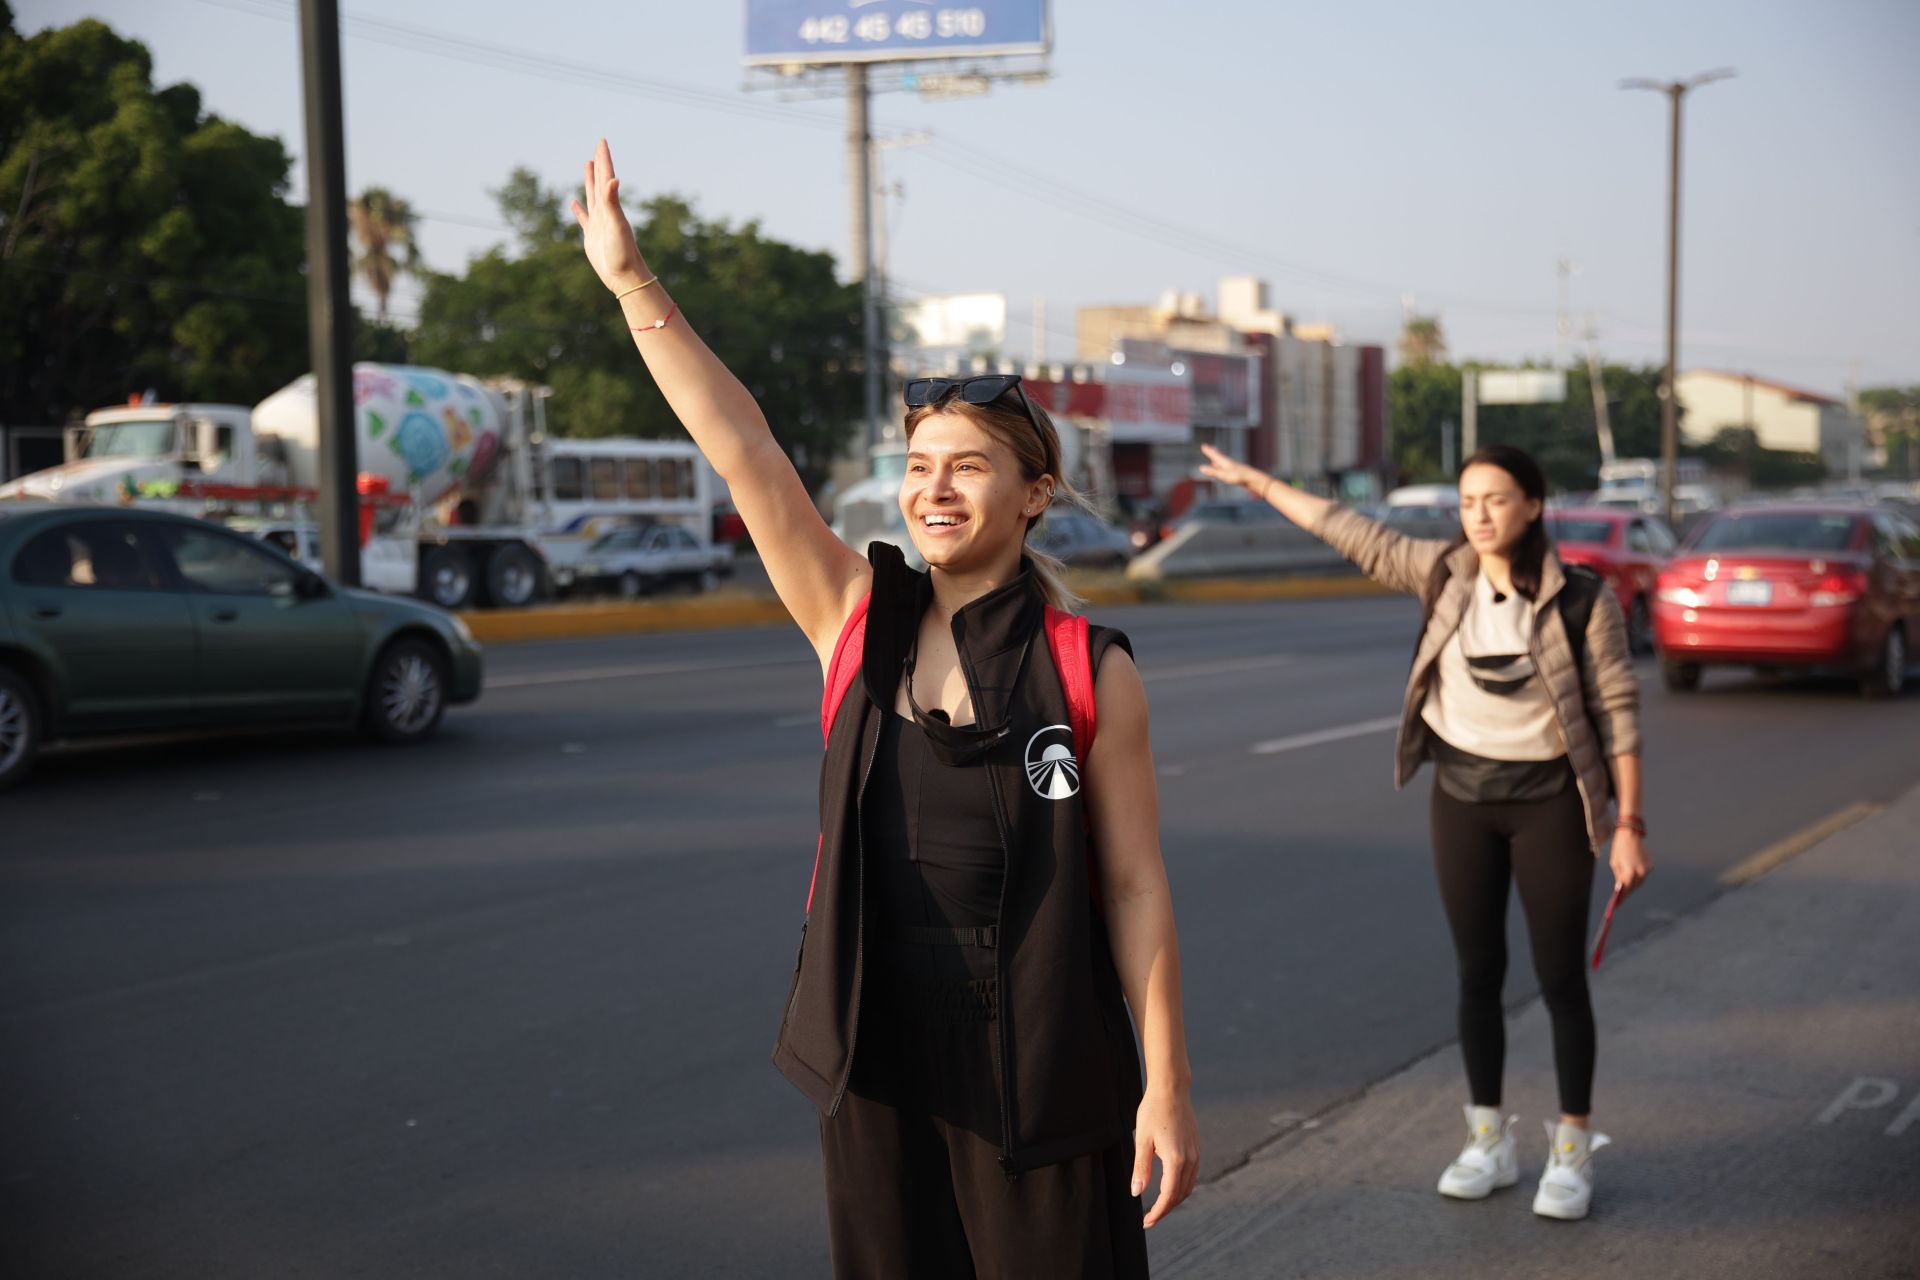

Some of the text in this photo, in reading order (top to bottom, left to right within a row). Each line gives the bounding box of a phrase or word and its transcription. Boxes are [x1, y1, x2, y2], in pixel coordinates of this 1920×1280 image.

[799, 15, 850, 44] 442
[855, 12, 890, 42] 45
[895, 10, 931, 40] 45
